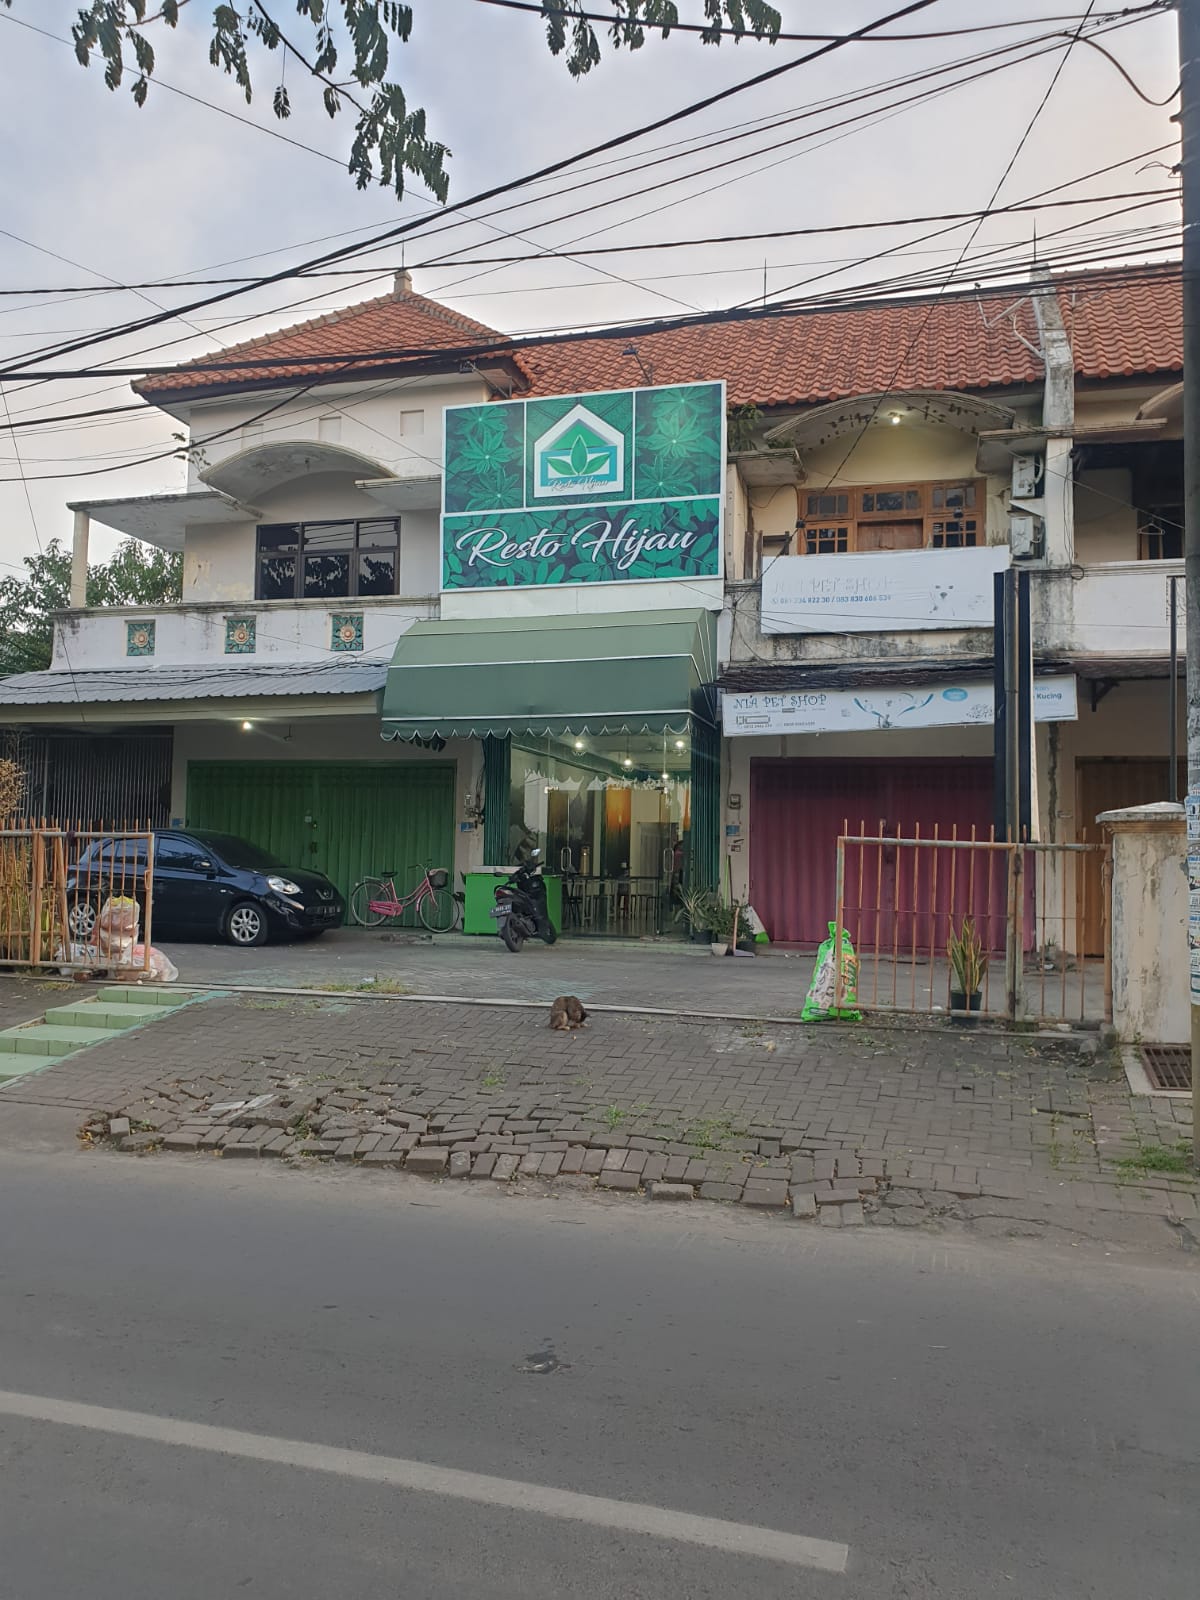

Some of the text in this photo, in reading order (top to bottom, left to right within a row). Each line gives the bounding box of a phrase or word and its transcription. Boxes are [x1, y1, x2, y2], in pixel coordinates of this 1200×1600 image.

[455, 519, 697, 570] Resto Hijau
[763, 694, 787, 708] PET
[790, 693, 827, 708] SHOP
[1036, 691, 1063, 701] Kucing
